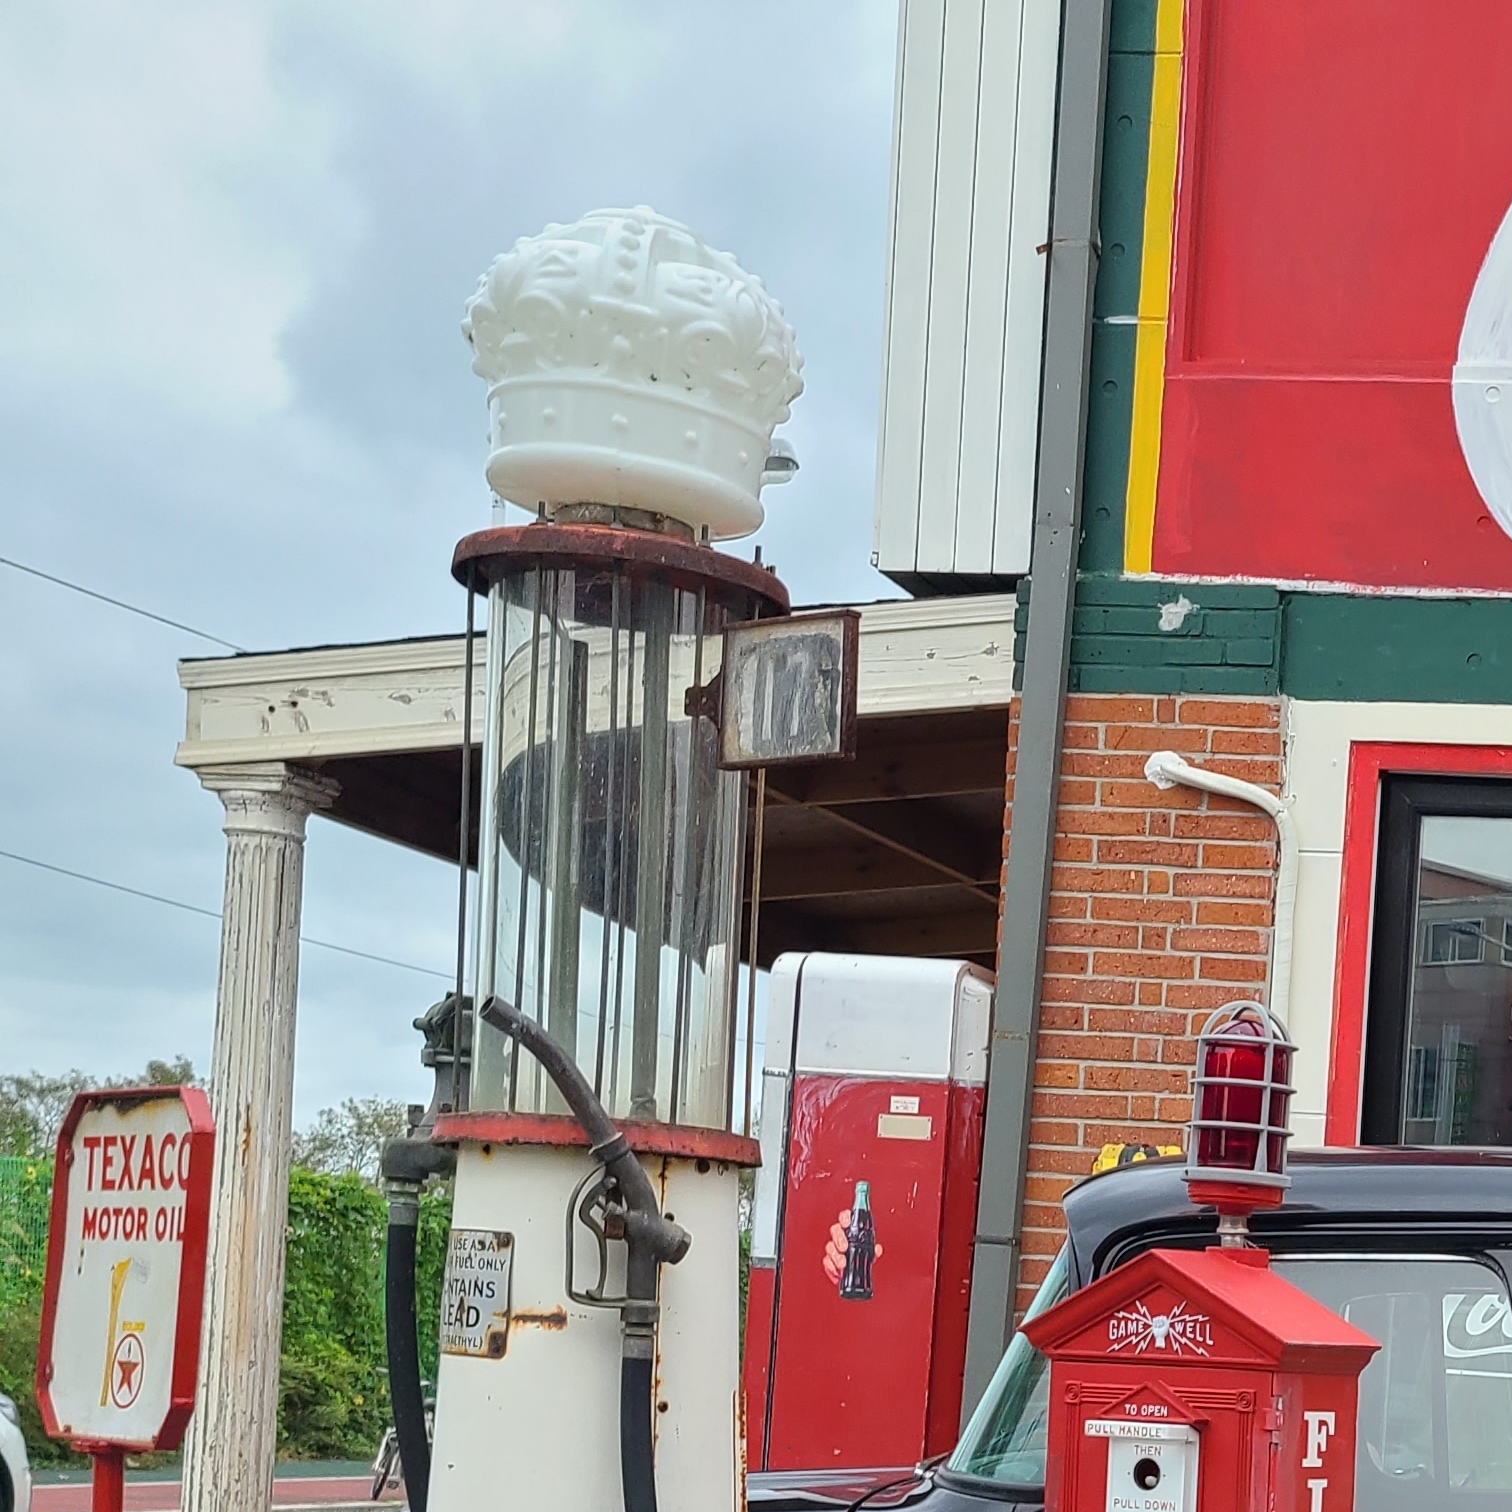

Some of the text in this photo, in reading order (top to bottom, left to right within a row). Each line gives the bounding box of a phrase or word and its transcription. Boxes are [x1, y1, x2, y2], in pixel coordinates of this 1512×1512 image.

[83, 1132, 193, 1192] TEXACO
[82, 1206, 185, 1242] MOTOR OIL
[453, 1238, 468, 1251] USE
[478, 1257, 506, 1272] ONLY
[448, 1278, 496, 1299] NTAINS
[443, 1303, 480, 1329] LEAD
[1124, 1403, 1168, 1417] TO OPEN
[1087, 1423, 1162, 1438] PULL HANDLE
[1134, 1444, 1162, 1456] THEN
[1113, 1498, 1176, 1512] PULL DOWN
